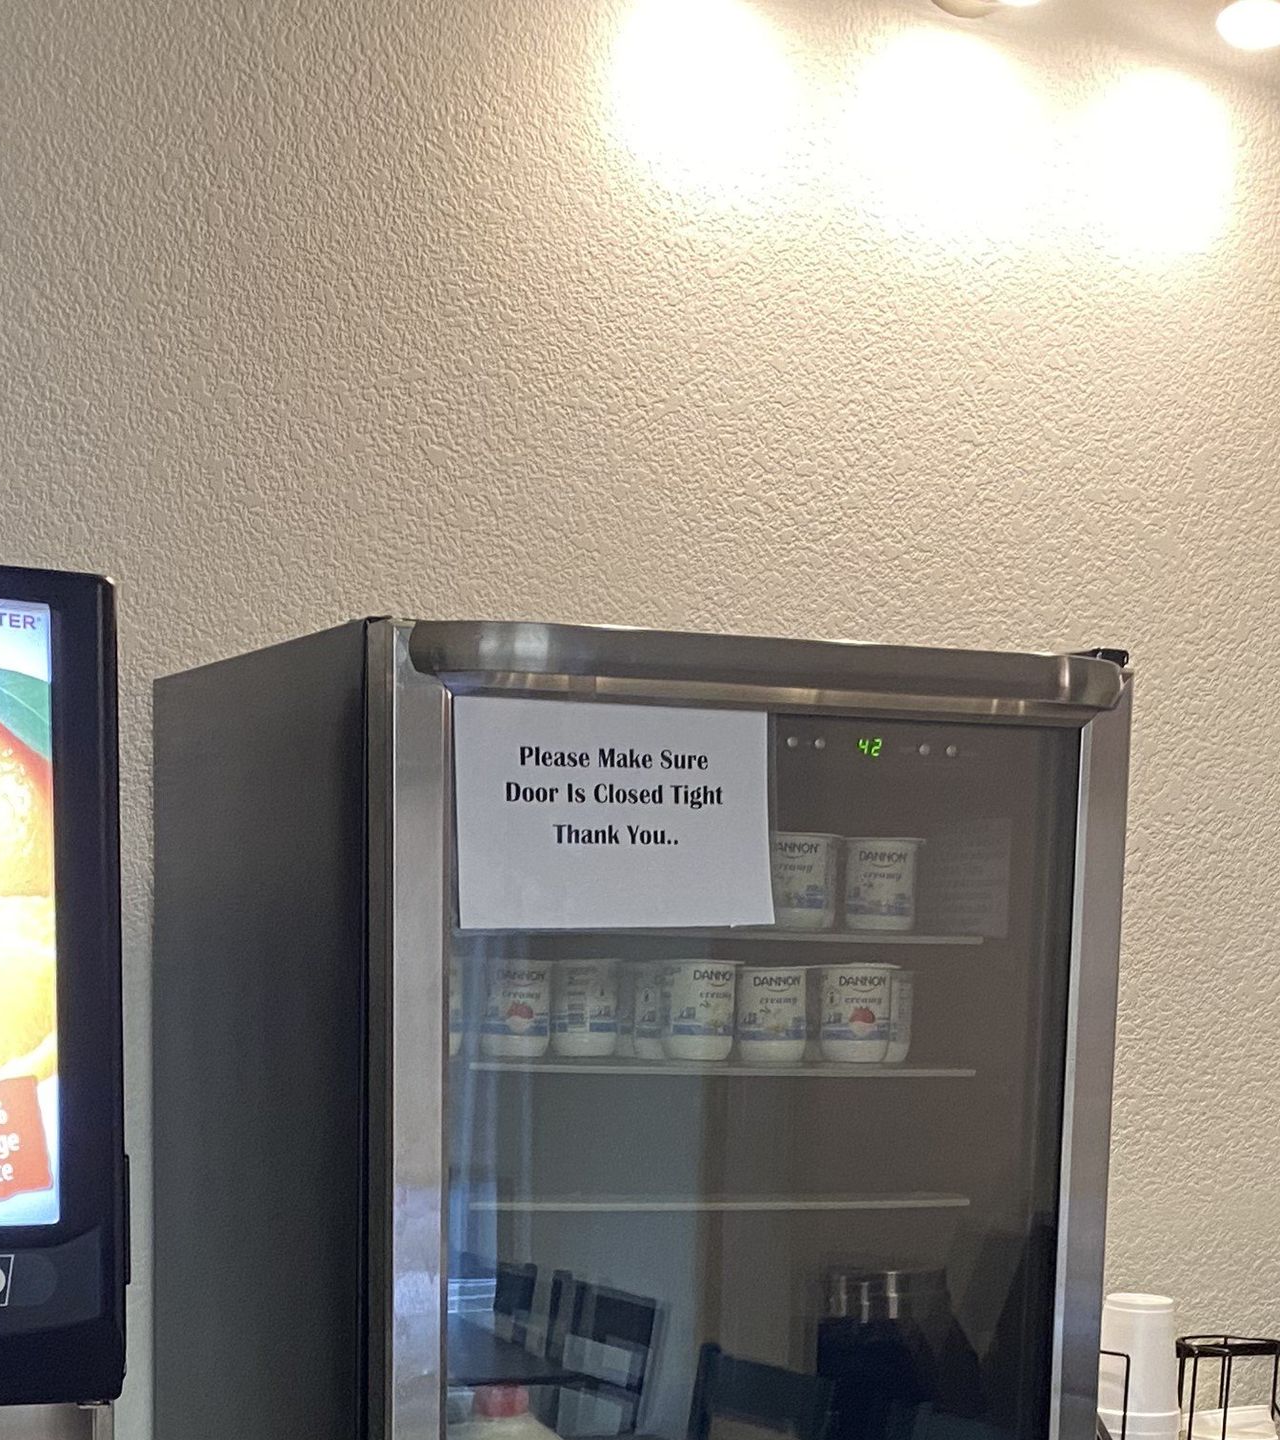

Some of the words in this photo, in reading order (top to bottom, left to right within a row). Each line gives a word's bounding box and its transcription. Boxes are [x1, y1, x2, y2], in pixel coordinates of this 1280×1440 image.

[857, 738, 883, 757] 42
[519, 746, 590, 767] Please
[598, 748, 653, 769] Make
[660, 749, 709, 770] Sure
[505, 782, 559, 803] Door
[567, 783, 586, 803] Is
[593, 783, 663, 804] Closed
[670, 785, 723, 809] Tight
[553, 824, 620, 845] Thank
[627, 825, 679, 846] You..
[859, 851, 907, 862] DANNON
[693, 970, 733, 982] DANNO
[753, 976, 801, 987] DANNON
[839, 976, 886, 988] DANNON
